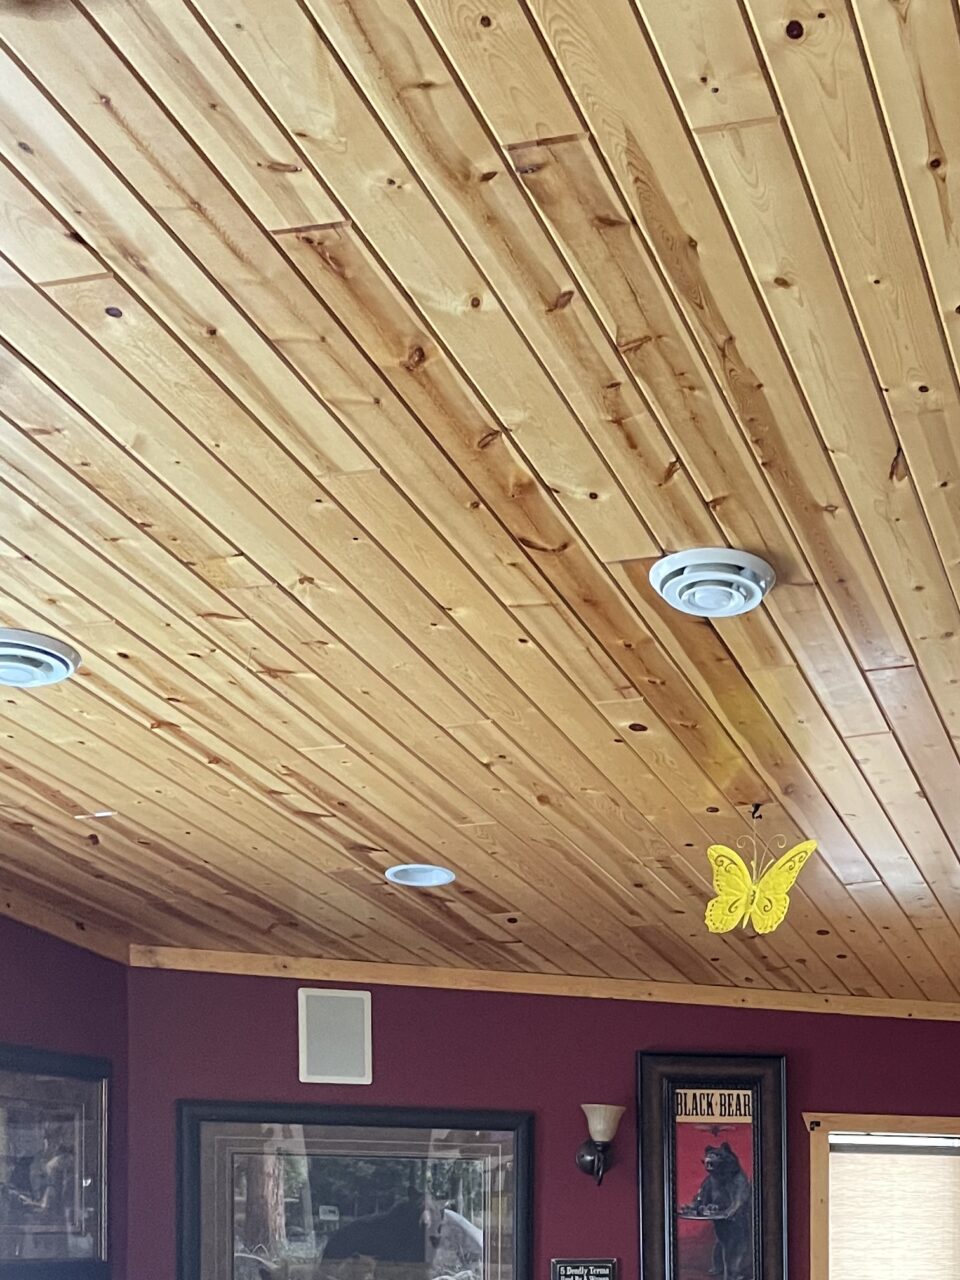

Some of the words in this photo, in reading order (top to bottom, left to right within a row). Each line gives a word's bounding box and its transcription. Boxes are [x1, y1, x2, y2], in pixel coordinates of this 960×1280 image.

[676, 1092, 715, 1117] BLACK
[719, 1093, 752, 1117] BEAR
[560, 1267, 565, 1275] 5
[589, 1266, 610, 1275] Terms
